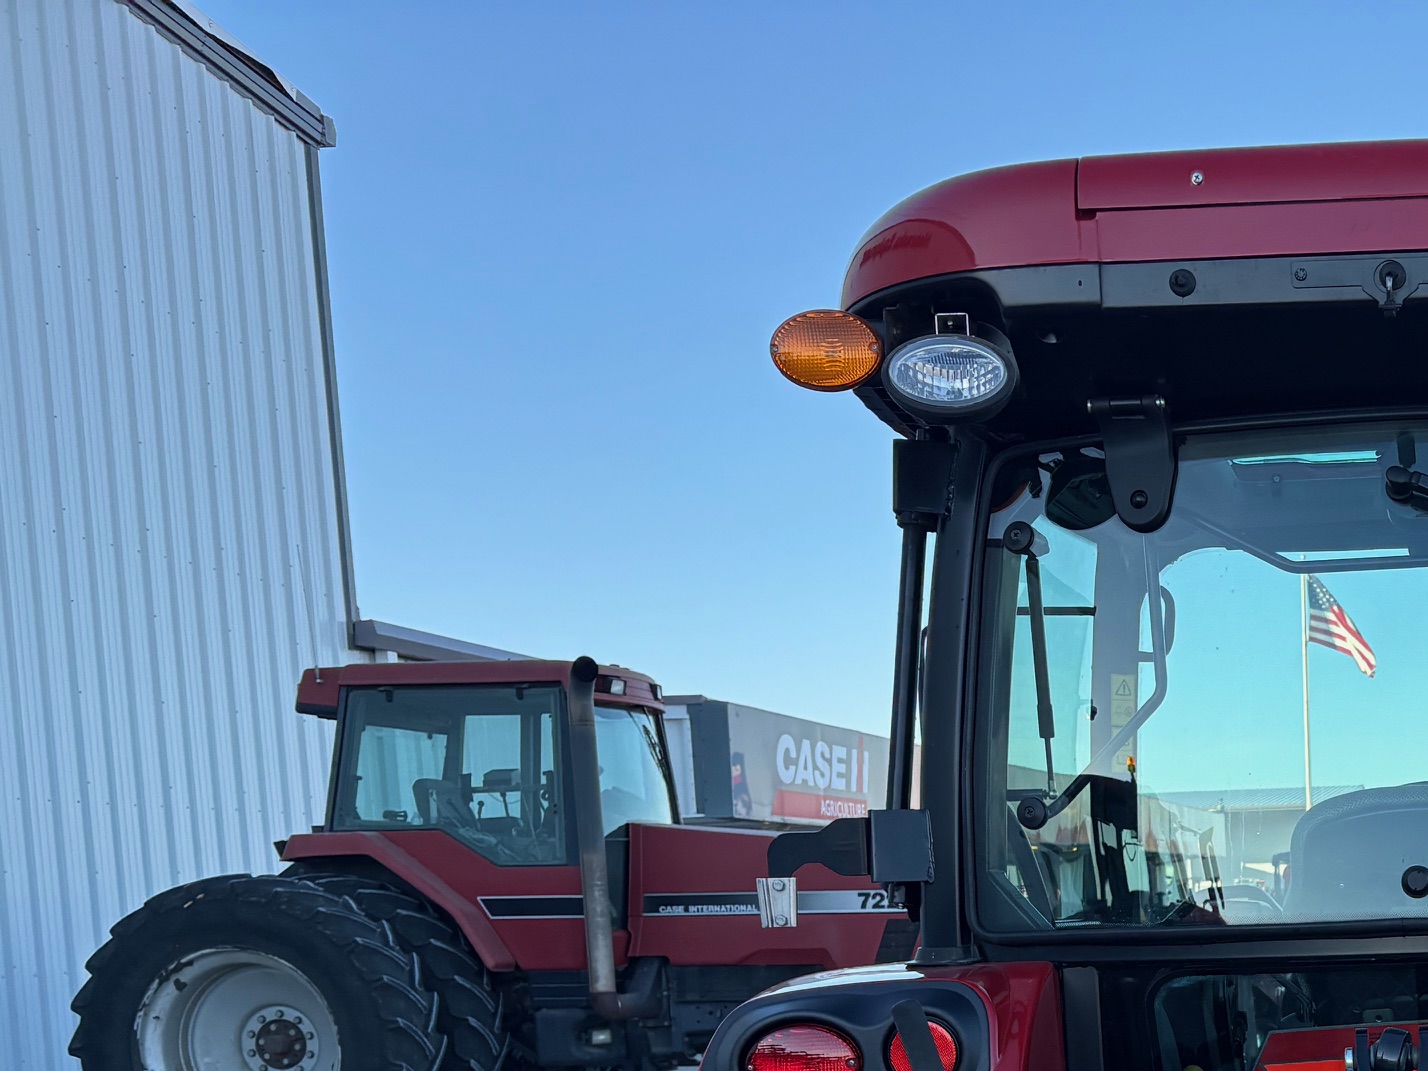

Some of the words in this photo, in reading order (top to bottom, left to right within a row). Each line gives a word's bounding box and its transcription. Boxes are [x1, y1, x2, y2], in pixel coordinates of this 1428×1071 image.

[776, 734, 847, 790] CASE
[820, 800, 866, 818] AGRICULTURE
[659, 905, 685, 914] CASE
[689, 904, 758, 913] INTERNATIONAL
